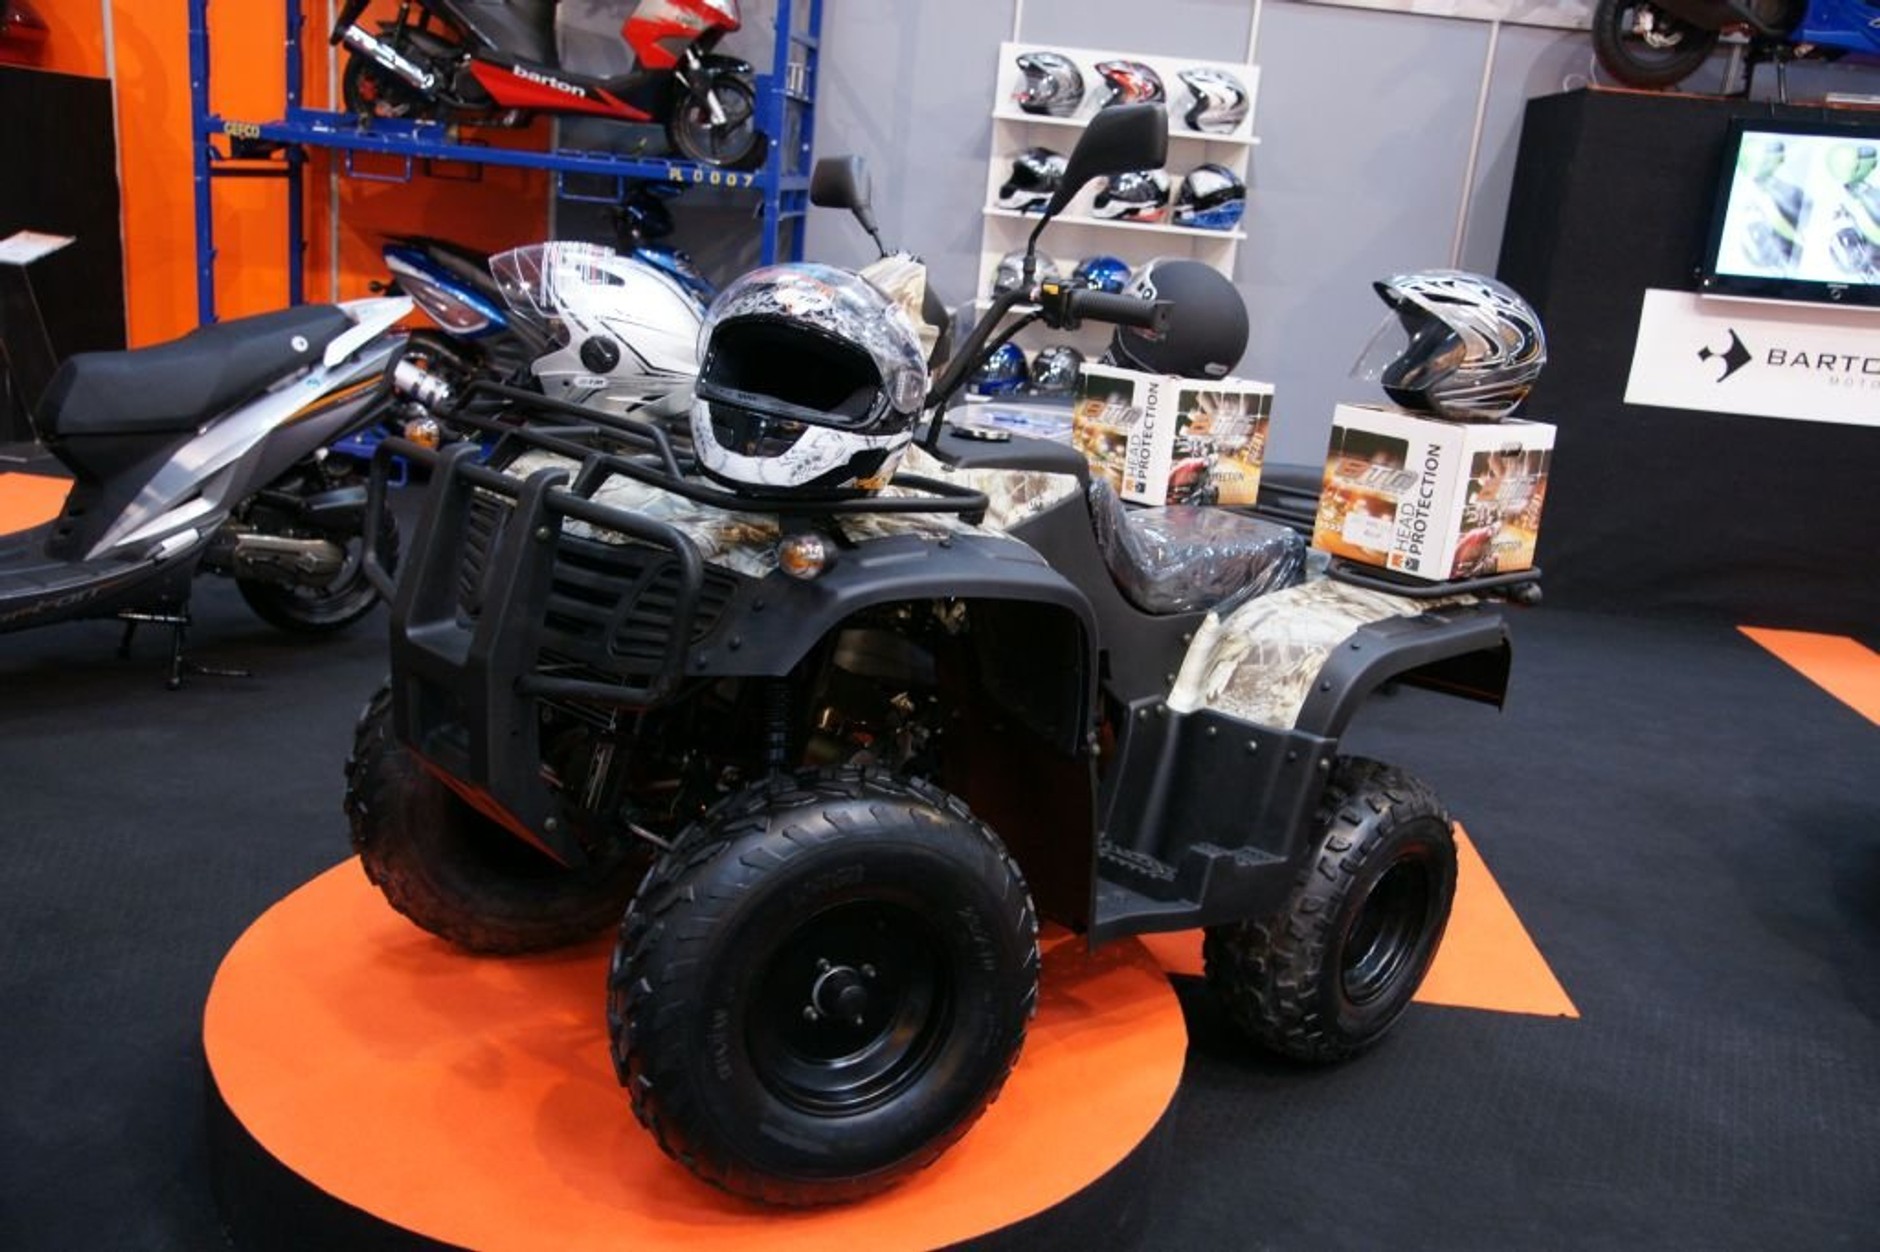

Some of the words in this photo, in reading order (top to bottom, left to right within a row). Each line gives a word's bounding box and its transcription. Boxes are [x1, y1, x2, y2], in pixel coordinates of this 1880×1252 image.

[512, 64, 586, 98] barton
[223, 121, 260, 139] GEFCO
[1137, 382, 1160, 480] PROTECTION
[1127, 433, 1141, 477] HEAD
[1408, 443, 1442, 556] PROTECTION
[1395, 502, 1417, 552] HEAD
